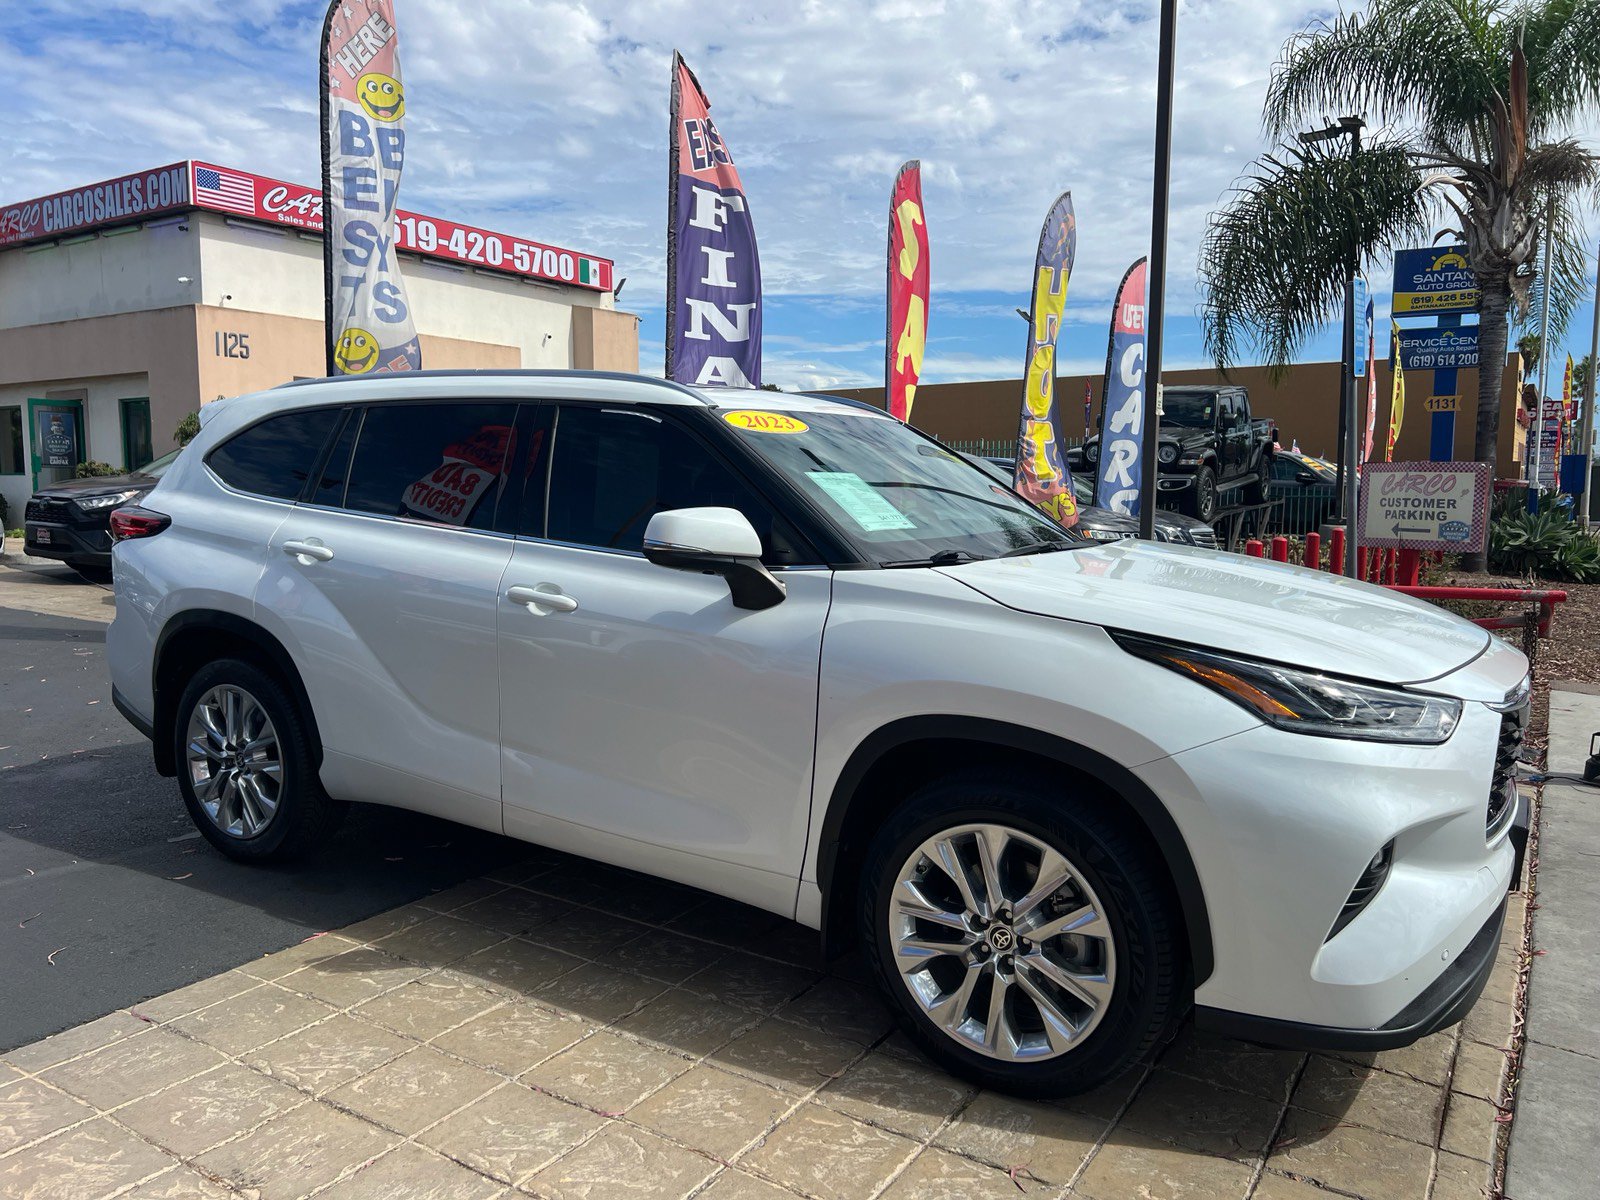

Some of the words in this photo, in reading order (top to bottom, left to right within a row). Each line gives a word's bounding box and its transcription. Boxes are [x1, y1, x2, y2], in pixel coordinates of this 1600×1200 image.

[335, 11, 396, 80] HERE
[683, 116, 735, 172] EAS
[42, 166, 188, 233] CARCOSALES.COM
[278, 213, 304, 226] Sales
[307, 220, 323, 229] and
[338, 109, 380, 318] BEST
[394, 214, 574, 281] 619-420-5700
[1415, 283, 1444, 291] AUTO
[1445, 280, 1478, 289] GROU
[1411, 295, 1434, 305] (619)
[215, 331, 250, 359] 1125
[1416, 346, 1439, 354] Quality
[1409, 355, 1435, 368] (619)
[1437, 354, 1456, 366] 614
[1025, 266, 1069, 482] HOT
[1427, 398, 1457, 410] 1131
[740, 414, 795, 430] 2023
[1380, 473, 1457, 496] CARCO
[1380, 497, 1457, 509] CUSTOMER
[1384, 509, 1448, 521] PARKING
